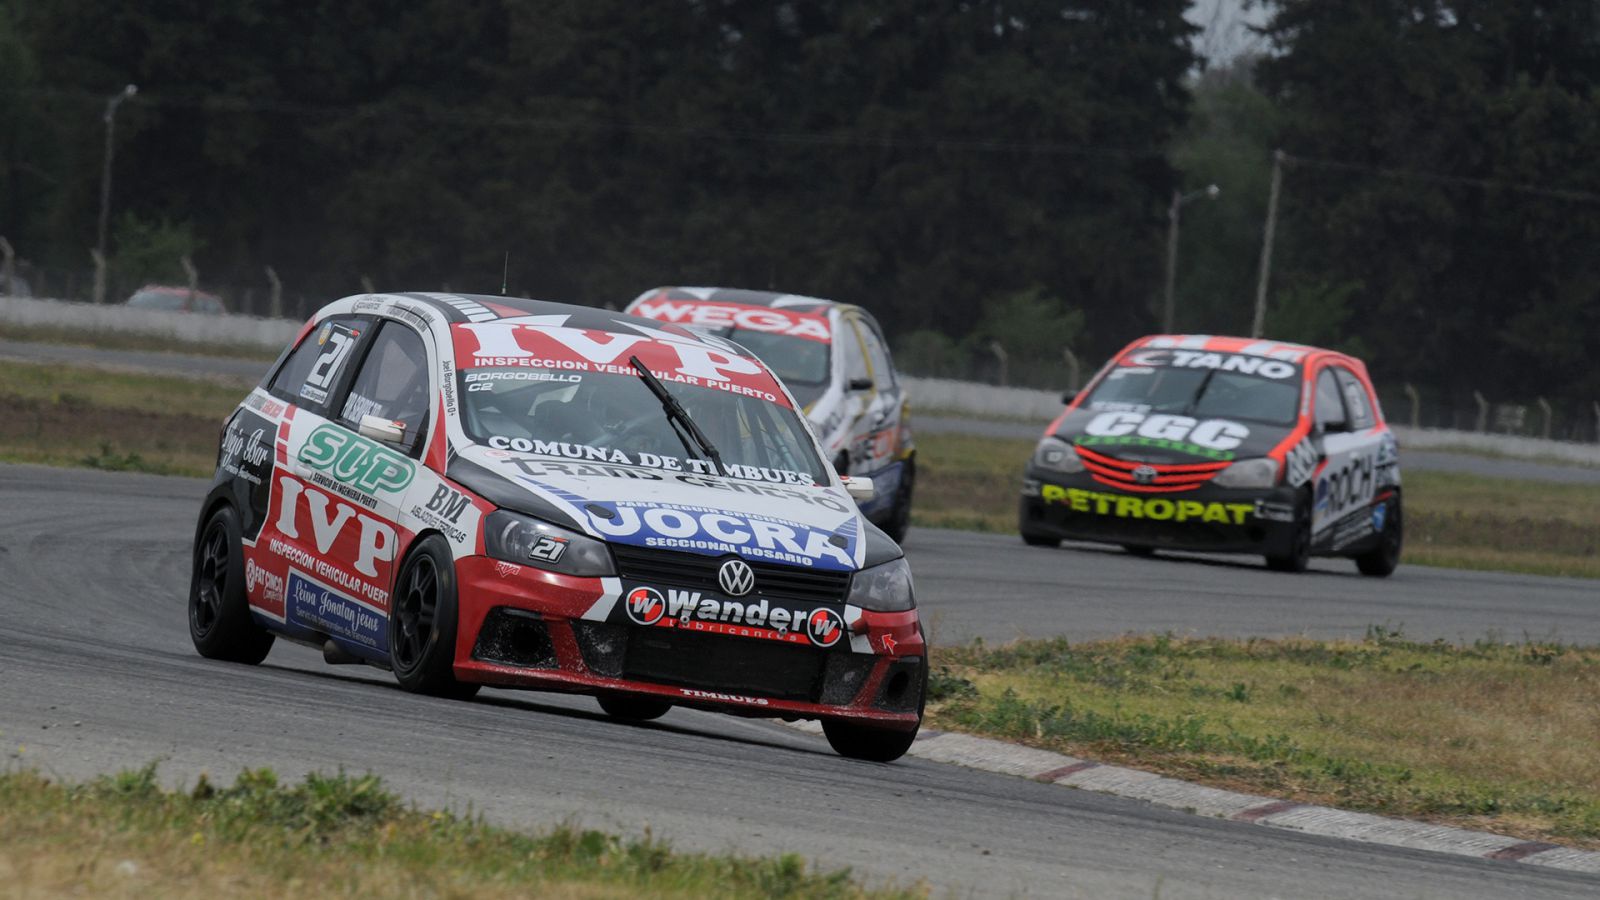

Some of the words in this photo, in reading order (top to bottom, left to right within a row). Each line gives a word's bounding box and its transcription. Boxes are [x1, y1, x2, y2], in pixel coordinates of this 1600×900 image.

[639, 301, 832, 340] WEGA
[306, 329, 354, 389] 21
[458, 321, 762, 382] IVP
[464, 372, 582, 384] BORGOBELLO
[468, 382, 494, 392] C2
[474, 357, 588, 371] INSPECCION
[706, 379, 777, 403] PUERTO
[1085, 411, 1250, 450] CGC
[298, 423, 416, 495] SUP
[488, 435, 632, 465] COMUNA
[638, 451, 683, 471] DE
[685, 457, 816, 487] TIMBUES
[312, 472, 333, 489] SERVICIO
[360, 493, 378, 510] PUERTO
[425, 482, 472, 525] BM
[615, 500, 658, 509] PARA
[661, 503, 720, 515] SEGUIR
[1042, 484, 1254, 525] PETROPAT
[275, 476, 399, 578] IVP
[600, 507, 854, 569] JOCRA
[269, 538, 316, 570] INSPECCION
[315, 559, 361, 593] VEHICULAR
[531, 537, 566, 561] 21
[645, 537, 738, 553] SECCIONAL
[741, 545, 812, 567] ROSARIO
[292, 580, 317, 606] Leiva
[319, 591, 355, 622] Jonatan
[667, 589, 807, 632] Wander
[680, 688, 769, 705] TIMBUES
